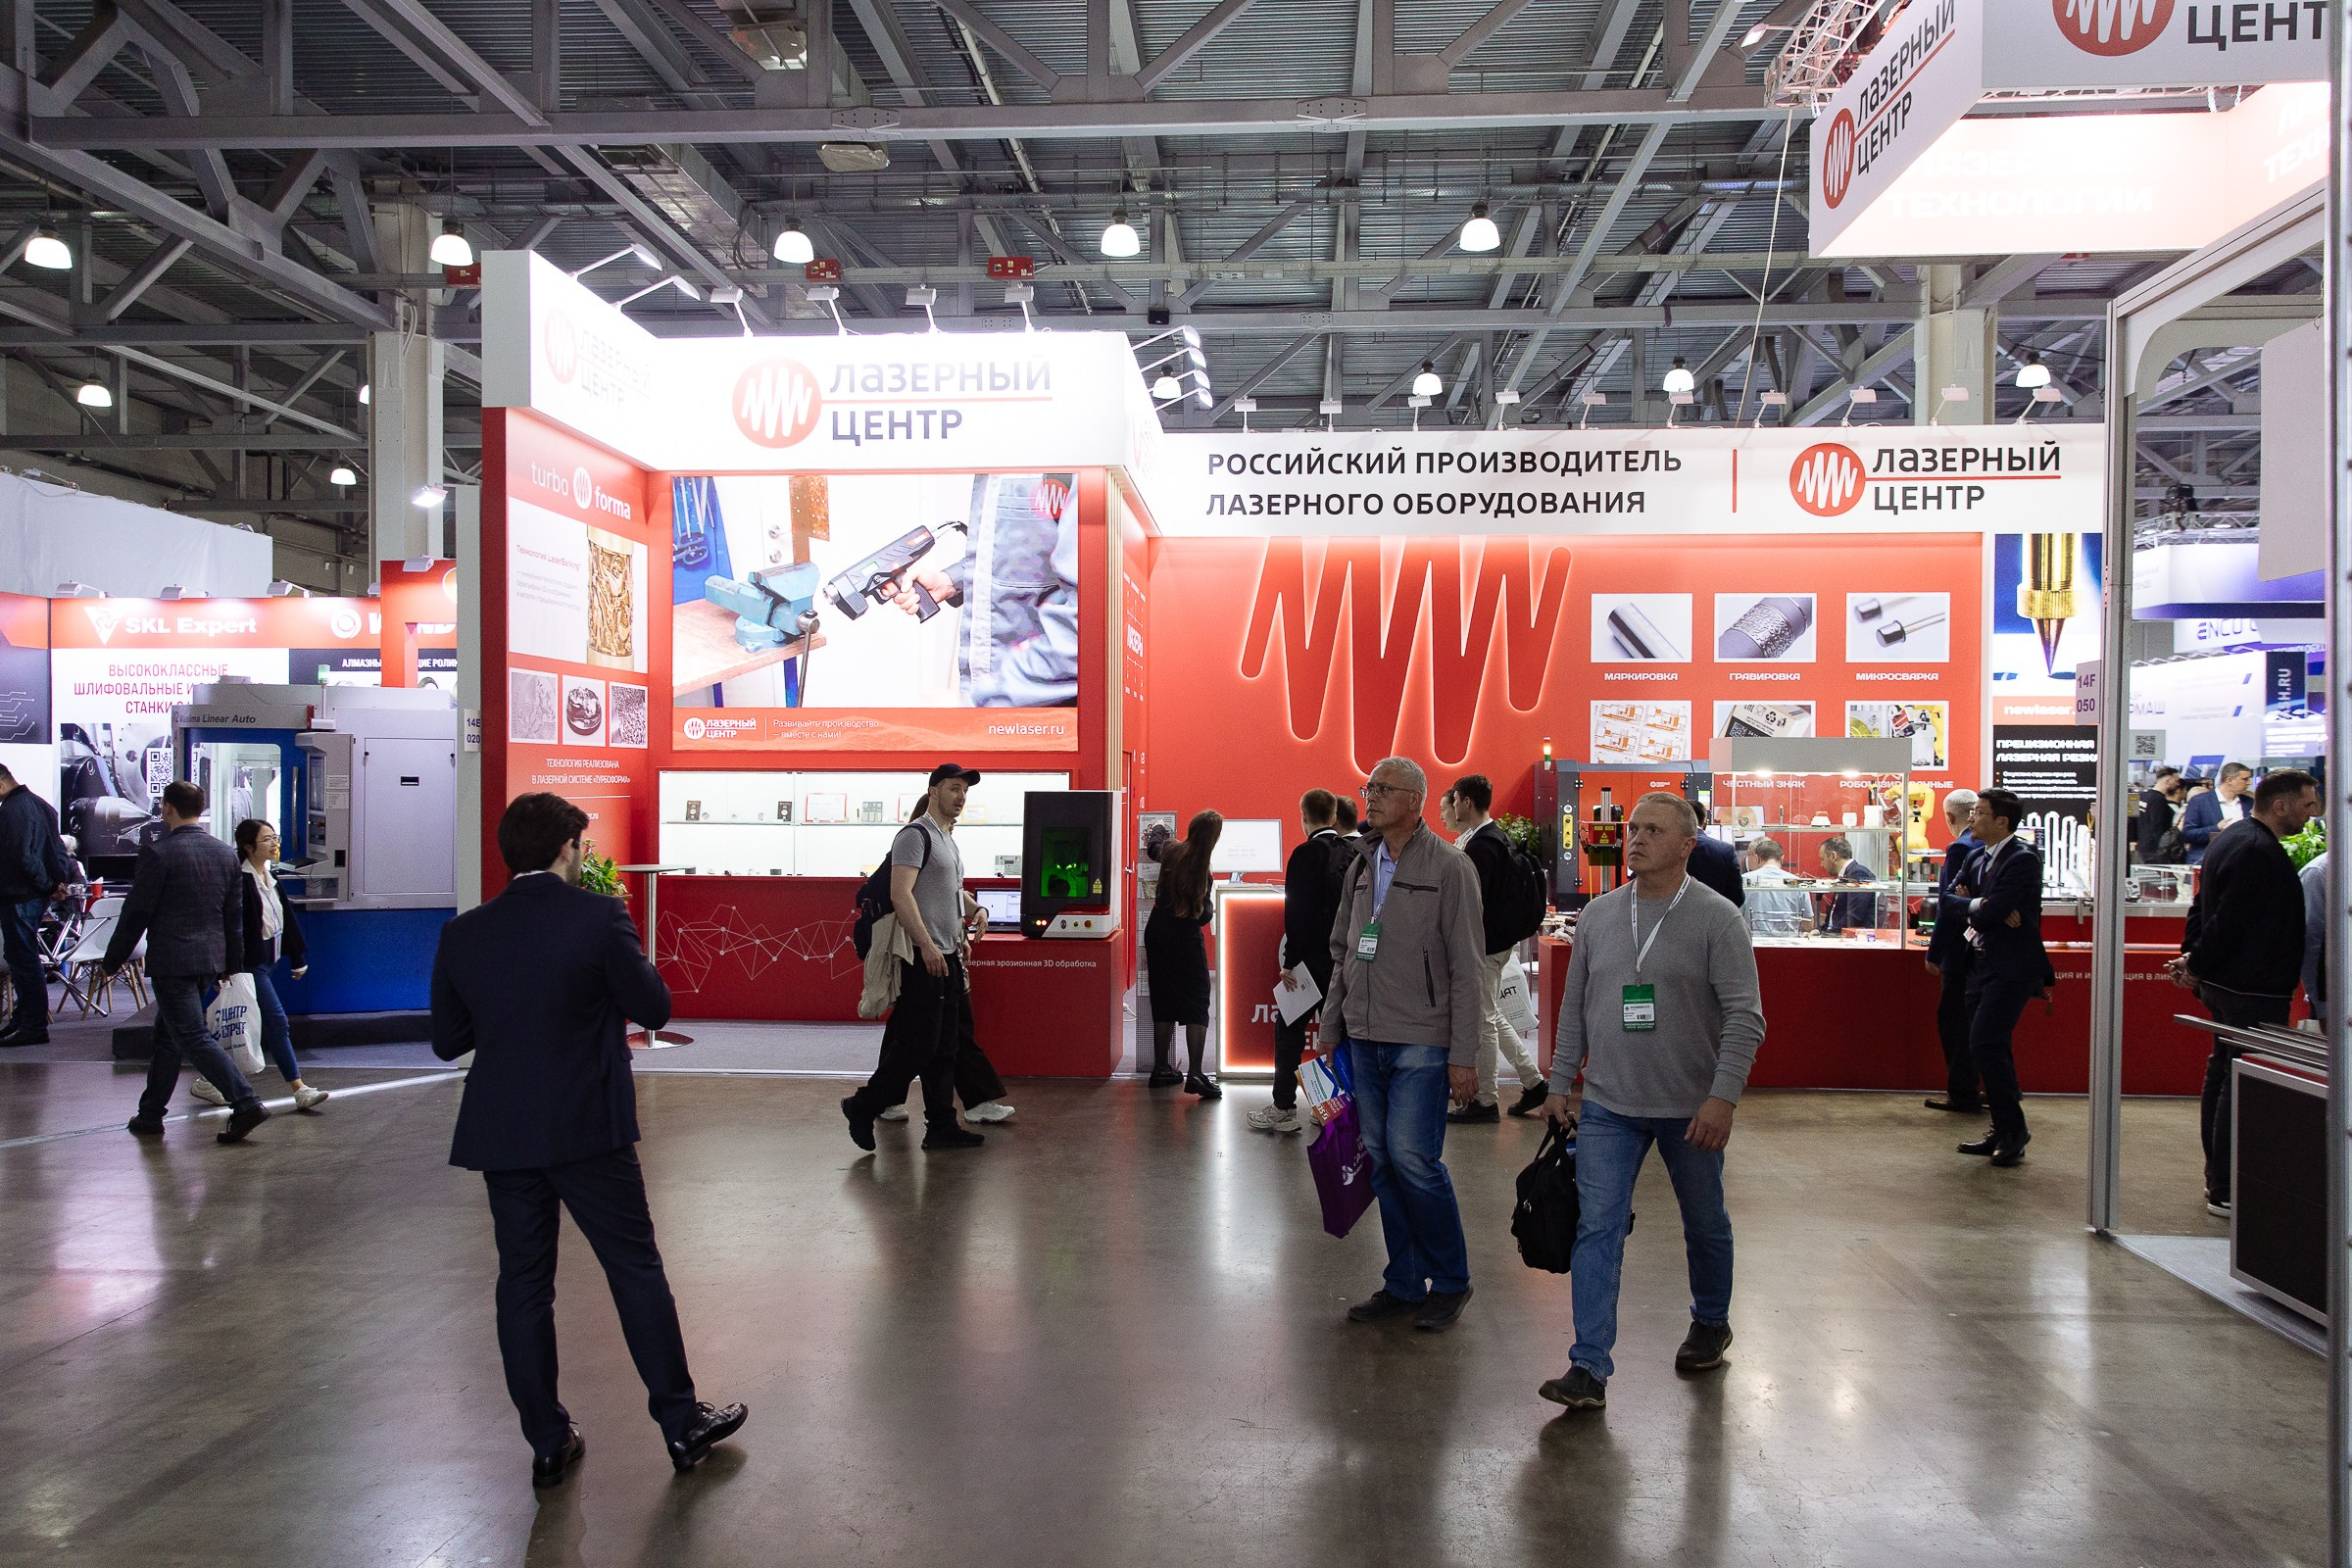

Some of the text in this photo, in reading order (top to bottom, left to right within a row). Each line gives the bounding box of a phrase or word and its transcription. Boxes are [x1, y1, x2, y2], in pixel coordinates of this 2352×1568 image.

[2187, 1, 2328, 52] ЦЕНТ
[1857, 91, 1913, 176] ЦЕНТР
[1888, 185, 2154, 220] ТЕХНОЛОГИИ
[831, 409, 963, 447] ЦЕНТР
[1208, 446, 1683, 479] РОССИЙСКИЙ ПРОИЗВОДИТЕЛЬ
[531, 461, 631, 520] turbo forma
[1206, 490, 1645, 519] ЛАЗЕРНОГО ОБОРУДОВАНИЯ
[1874, 485, 1985, 515] ЦЕНТР
[124, 617, 257, 637] SKL Expert
[342, 659, 382, 668] АЛМАЗНЫ
[432, 659, 458, 668] РОЛИК
[109, 663, 228, 677] ВЫСОКОКЛАССНЫЕ
[1855, 671, 1939, 681] МИКРОСВАРКА
[1603, 672, 1679, 681] МАРКИРОВКА
[1729, 672, 1800, 681] ГРАВИРОВКА
[2078, 674, 2096, 689] 14F
[74, 682, 183, 696] ШЛИФОВАЛЬНЫЕ
[2003, 704, 2077, 715] newlaser.
[2077, 698, 2095, 712] 050
[202, 713, 230, 723] Linear
[231, 714, 256, 724] Auto
[466, 717, 481, 728] 14E
[773, 718, 880, 730] Развивайте производство
[706, 729, 737, 740] ЦЕНТР
[822, 730, 842, 739] нами!
[988, 722, 1064, 737] newlaser.ru
[466, 733, 481, 744] 020
[1995, 739, 2095, 749] ПРЕЦИЗИОННАЯ
[546, 758, 620, 769] ТЕХНОЛОГИЯ РЕАЛИЗОВАНА
[536, 773, 568, 785] ЛАЗЕРНОЙ
[568, 774, 593, 784] СИСТЕМЕ
[1722, 778, 1806, 789] ЧЕСТНЫЙ ЗНАК
[963, 958, 996, 968] азерная
[996, 959, 1043, 969] эрозионная
[1054, 958, 1097, 969] обработка
[221, 1005, 247, 1023] ЦЕНТР
